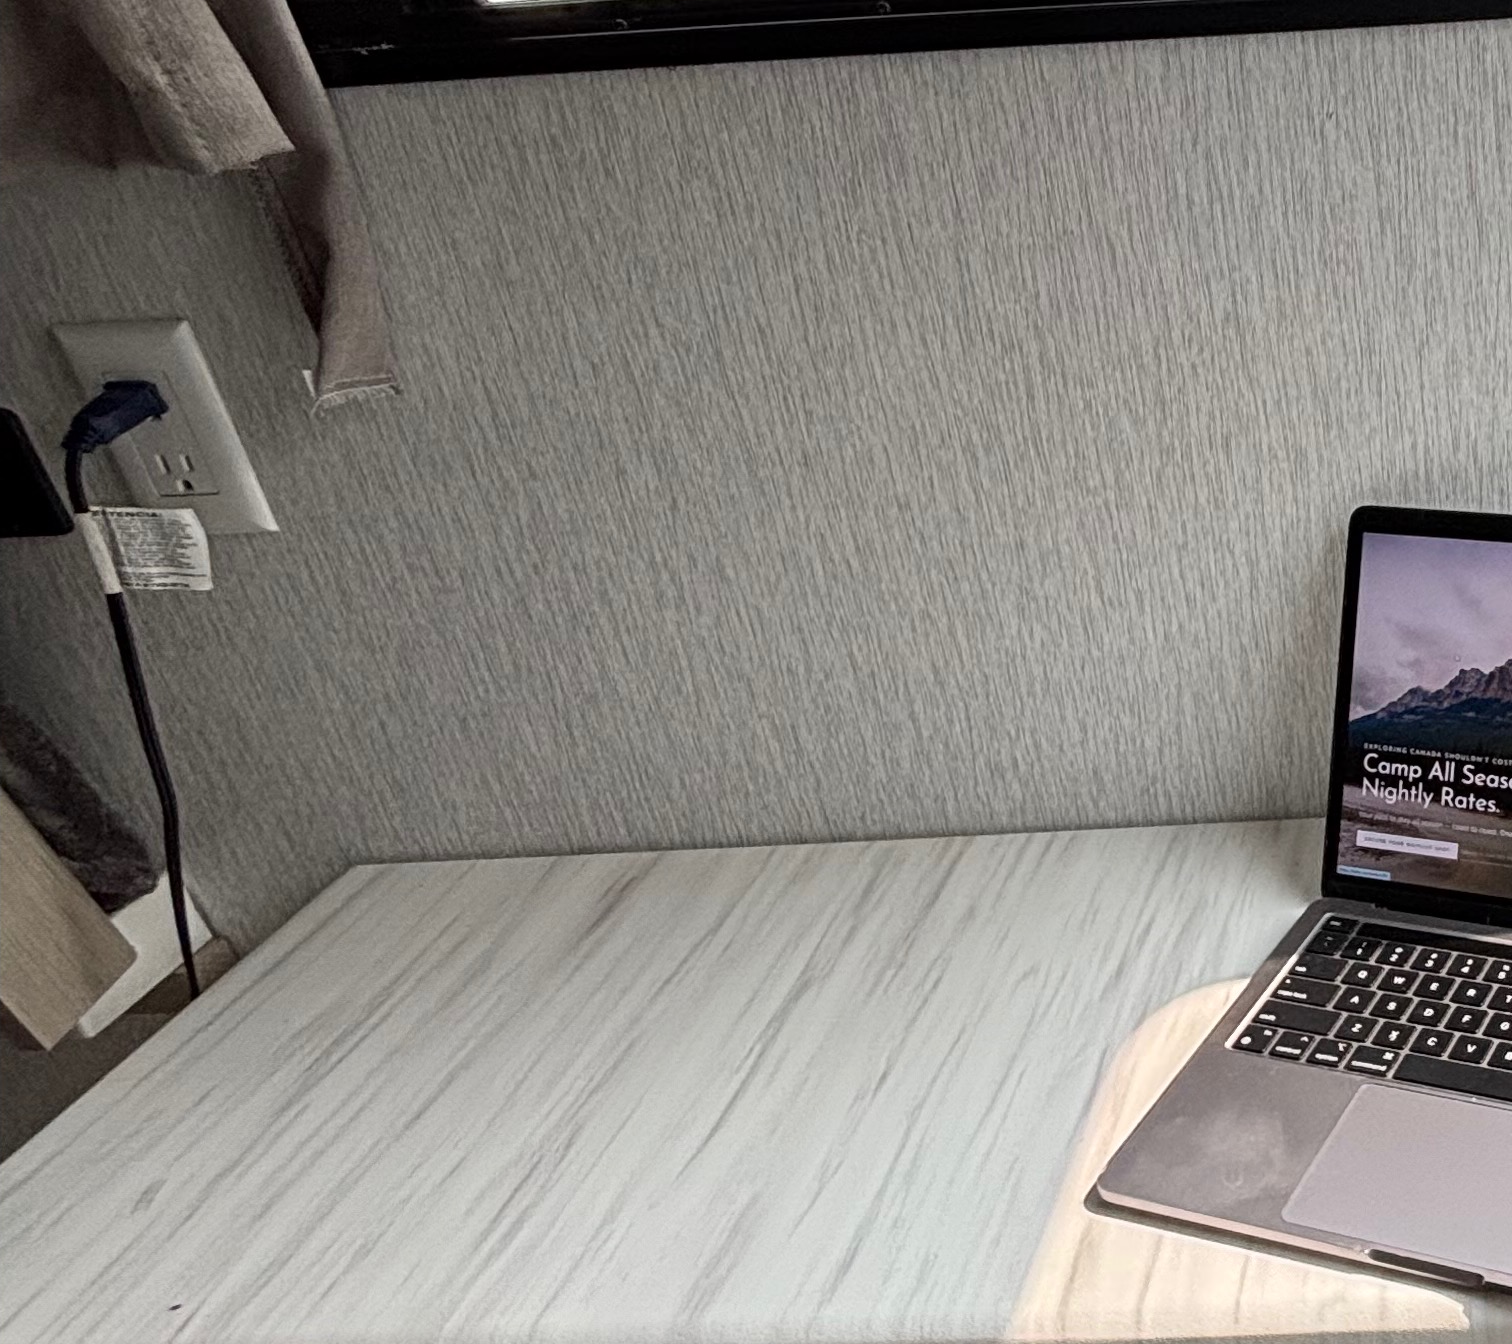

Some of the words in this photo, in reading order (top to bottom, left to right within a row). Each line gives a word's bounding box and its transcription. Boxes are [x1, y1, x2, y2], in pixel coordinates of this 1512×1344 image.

[1363, 742, 1407, 754] EXPLORING
[1410, 748, 1441, 758] CANADA
[1492, 757, 1512, 767] COST
[1363, 753, 1422, 782] Camp
[1428, 760, 1455, 782] All
[1361, 776, 1434, 809] Nightly
[1441, 786, 1501, 813] Rates.
